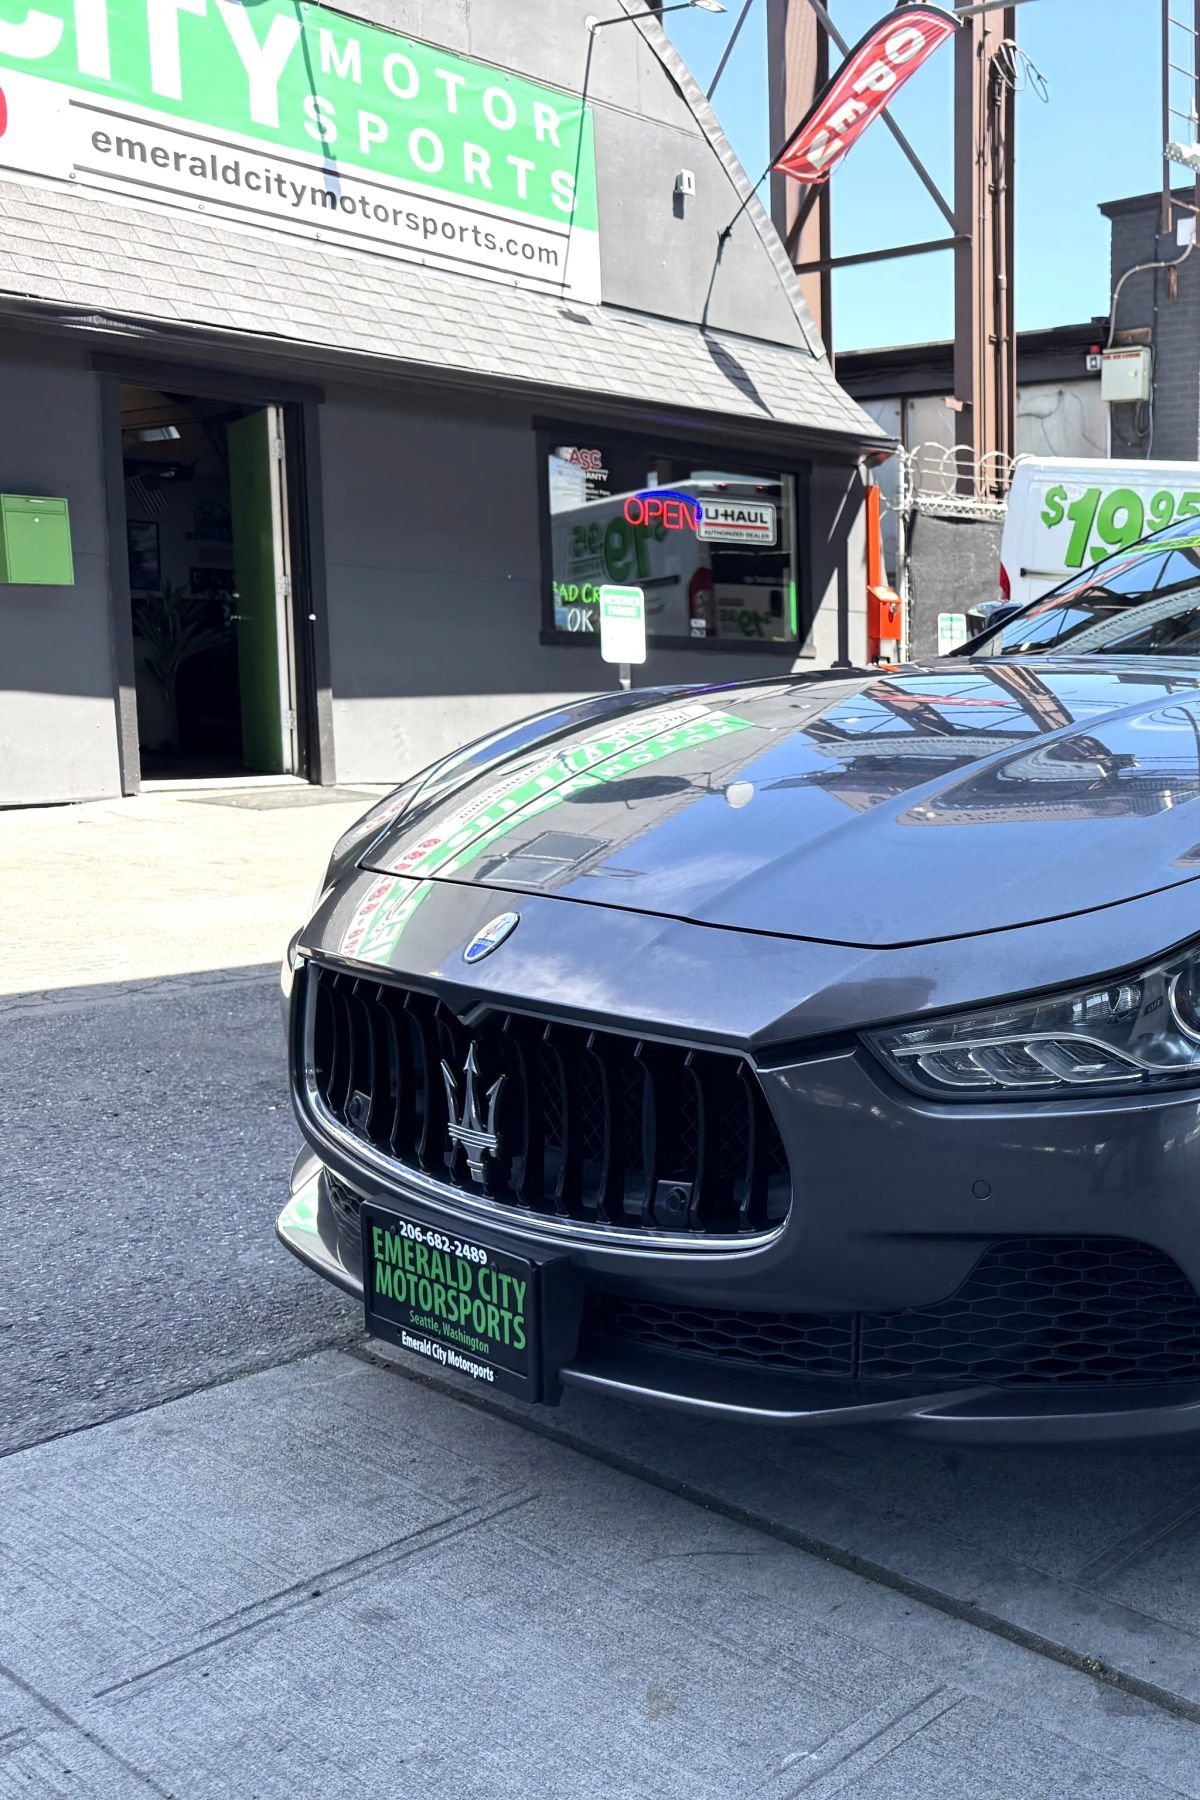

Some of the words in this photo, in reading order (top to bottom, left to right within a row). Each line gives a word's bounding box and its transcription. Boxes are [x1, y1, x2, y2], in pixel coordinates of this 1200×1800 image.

[319, 29, 562, 148] MOTOR
[806, 26, 926, 170] OPEN
[303, 94, 578, 213] SPORTS
[91, 129, 560, 268] emeraldcitymotorsports.com
[569, 448, 603, 470] ASC
[623, 496, 698, 532] OPEN
[704, 530, 745, 538] AUTHORIZED
[705, 508, 769, 524] U-HAUL
[567, 608, 595, 633] OK
[399, 1220, 488, 1266] 206-682-2489
[372, 1225, 472, 1292] EMERALD
[478, 1267, 527, 1314] CITY
[375, 1262, 526, 1350] MOTORSPORTS
[409, 1310, 441, 1335] Seattle,
[442, 1322, 490, 1354] Washington
[401, 1331, 432, 1355] Emerald
[432, 1343, 448, 1365] City
[448, 1350, 495, 1382] Motorsports
